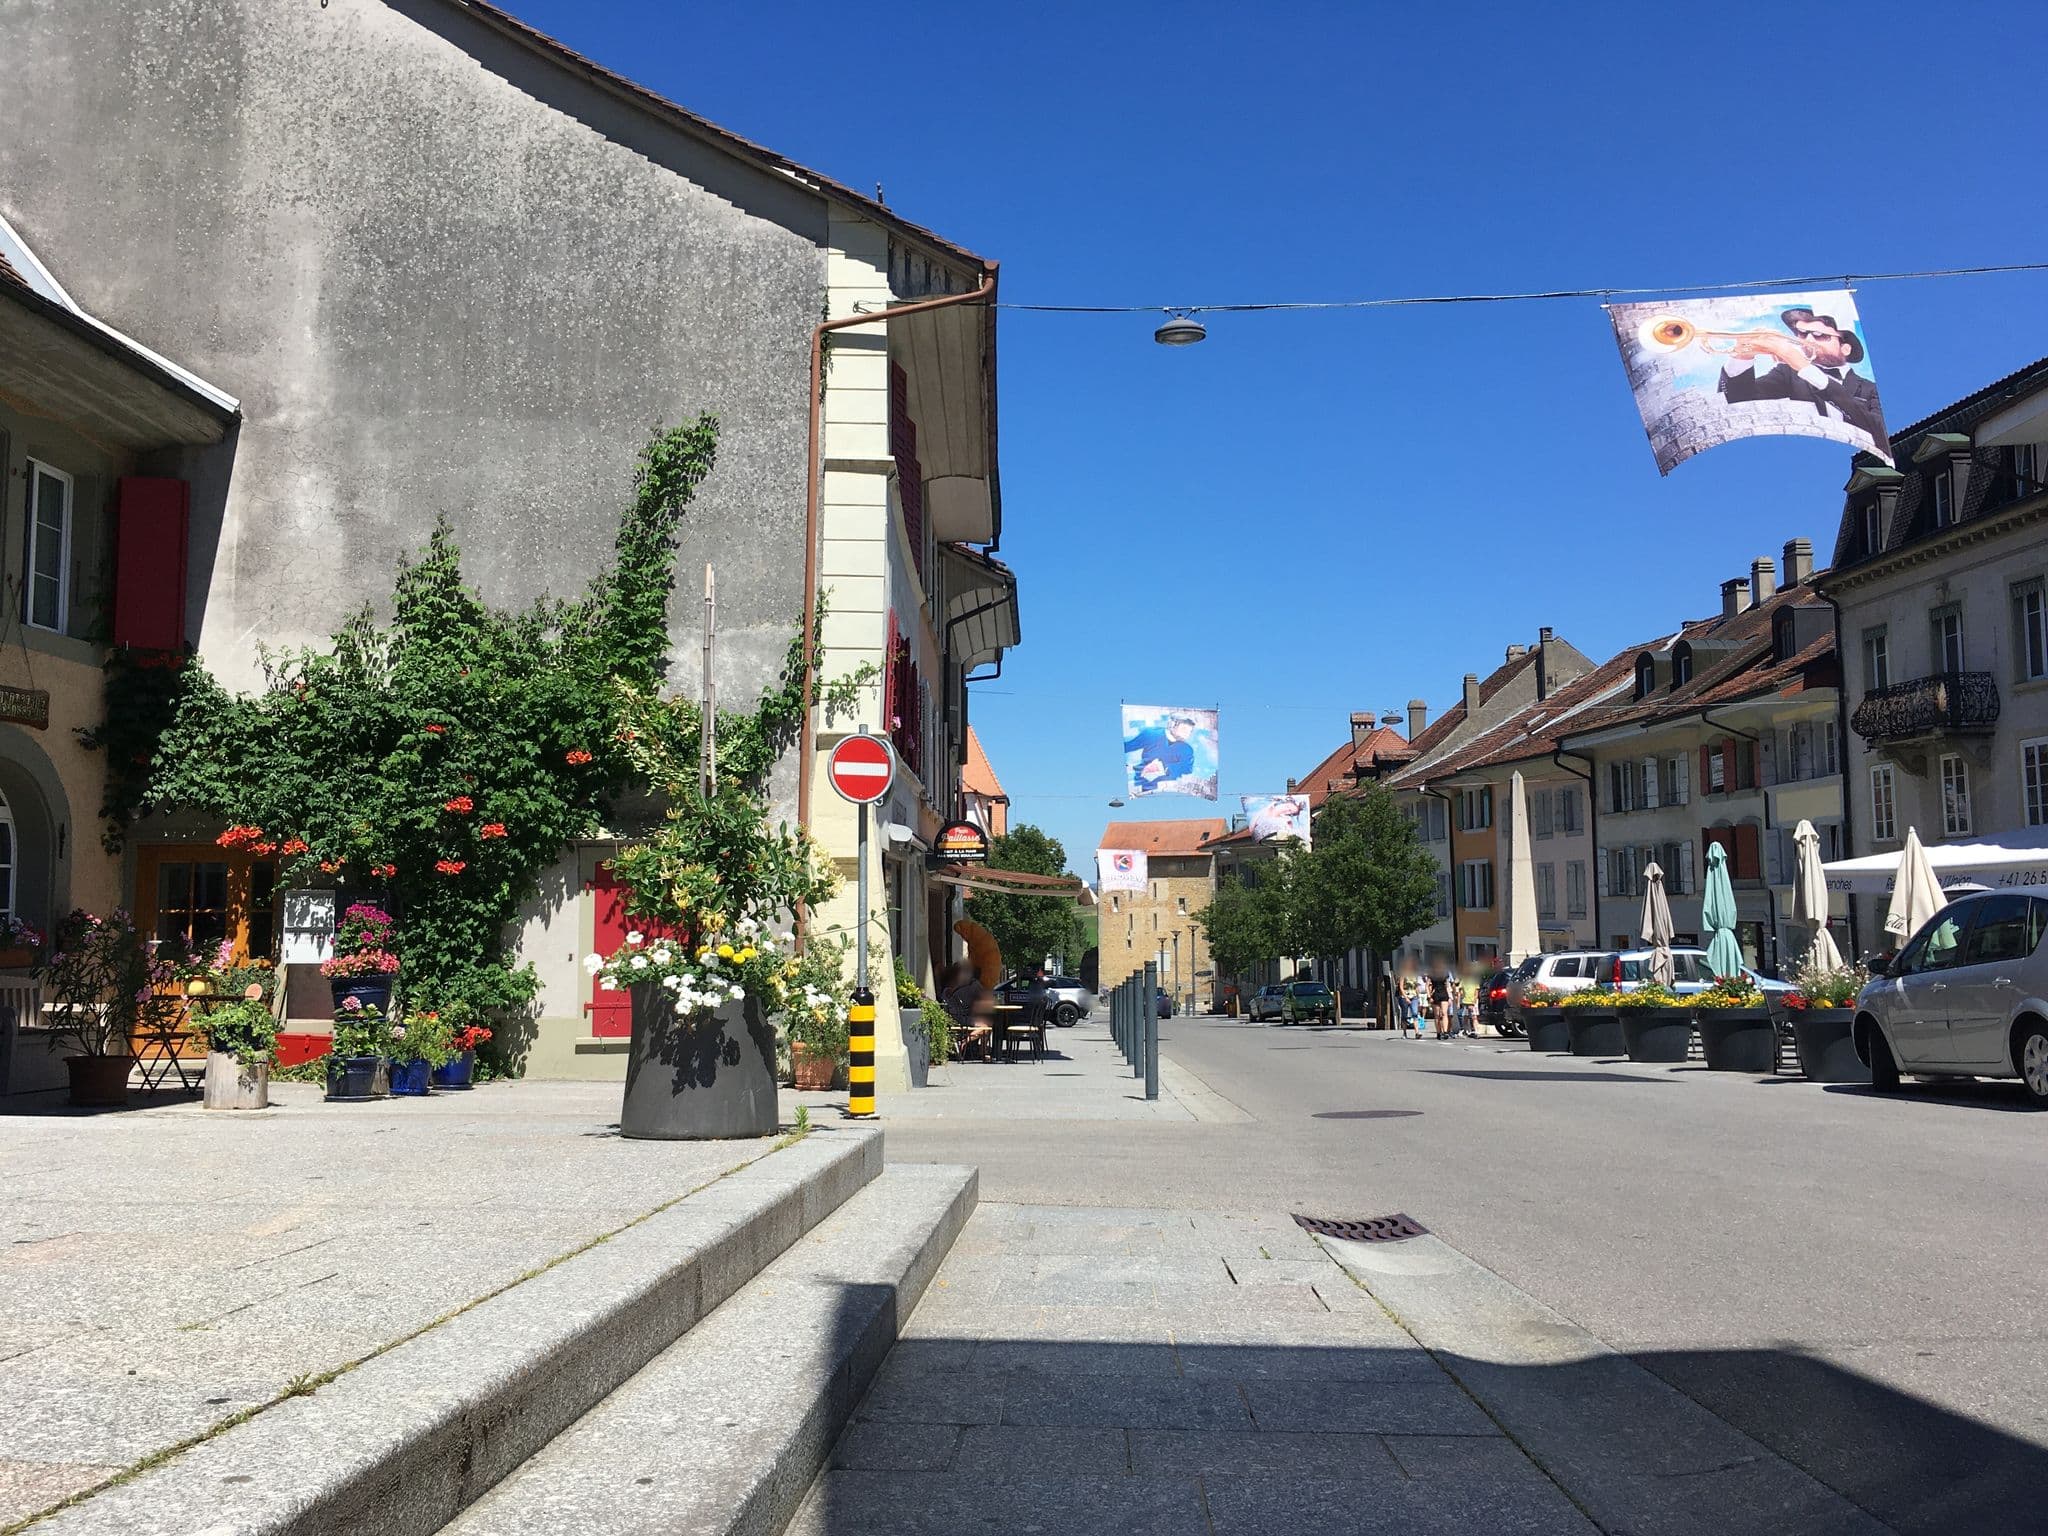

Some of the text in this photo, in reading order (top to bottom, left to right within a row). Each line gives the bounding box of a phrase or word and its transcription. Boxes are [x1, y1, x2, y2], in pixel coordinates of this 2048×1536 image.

[1826, 877, 1852, 890] enches
[1998, 872, 2019, 886] +41
[2023, 871, 2037, 886] 26
